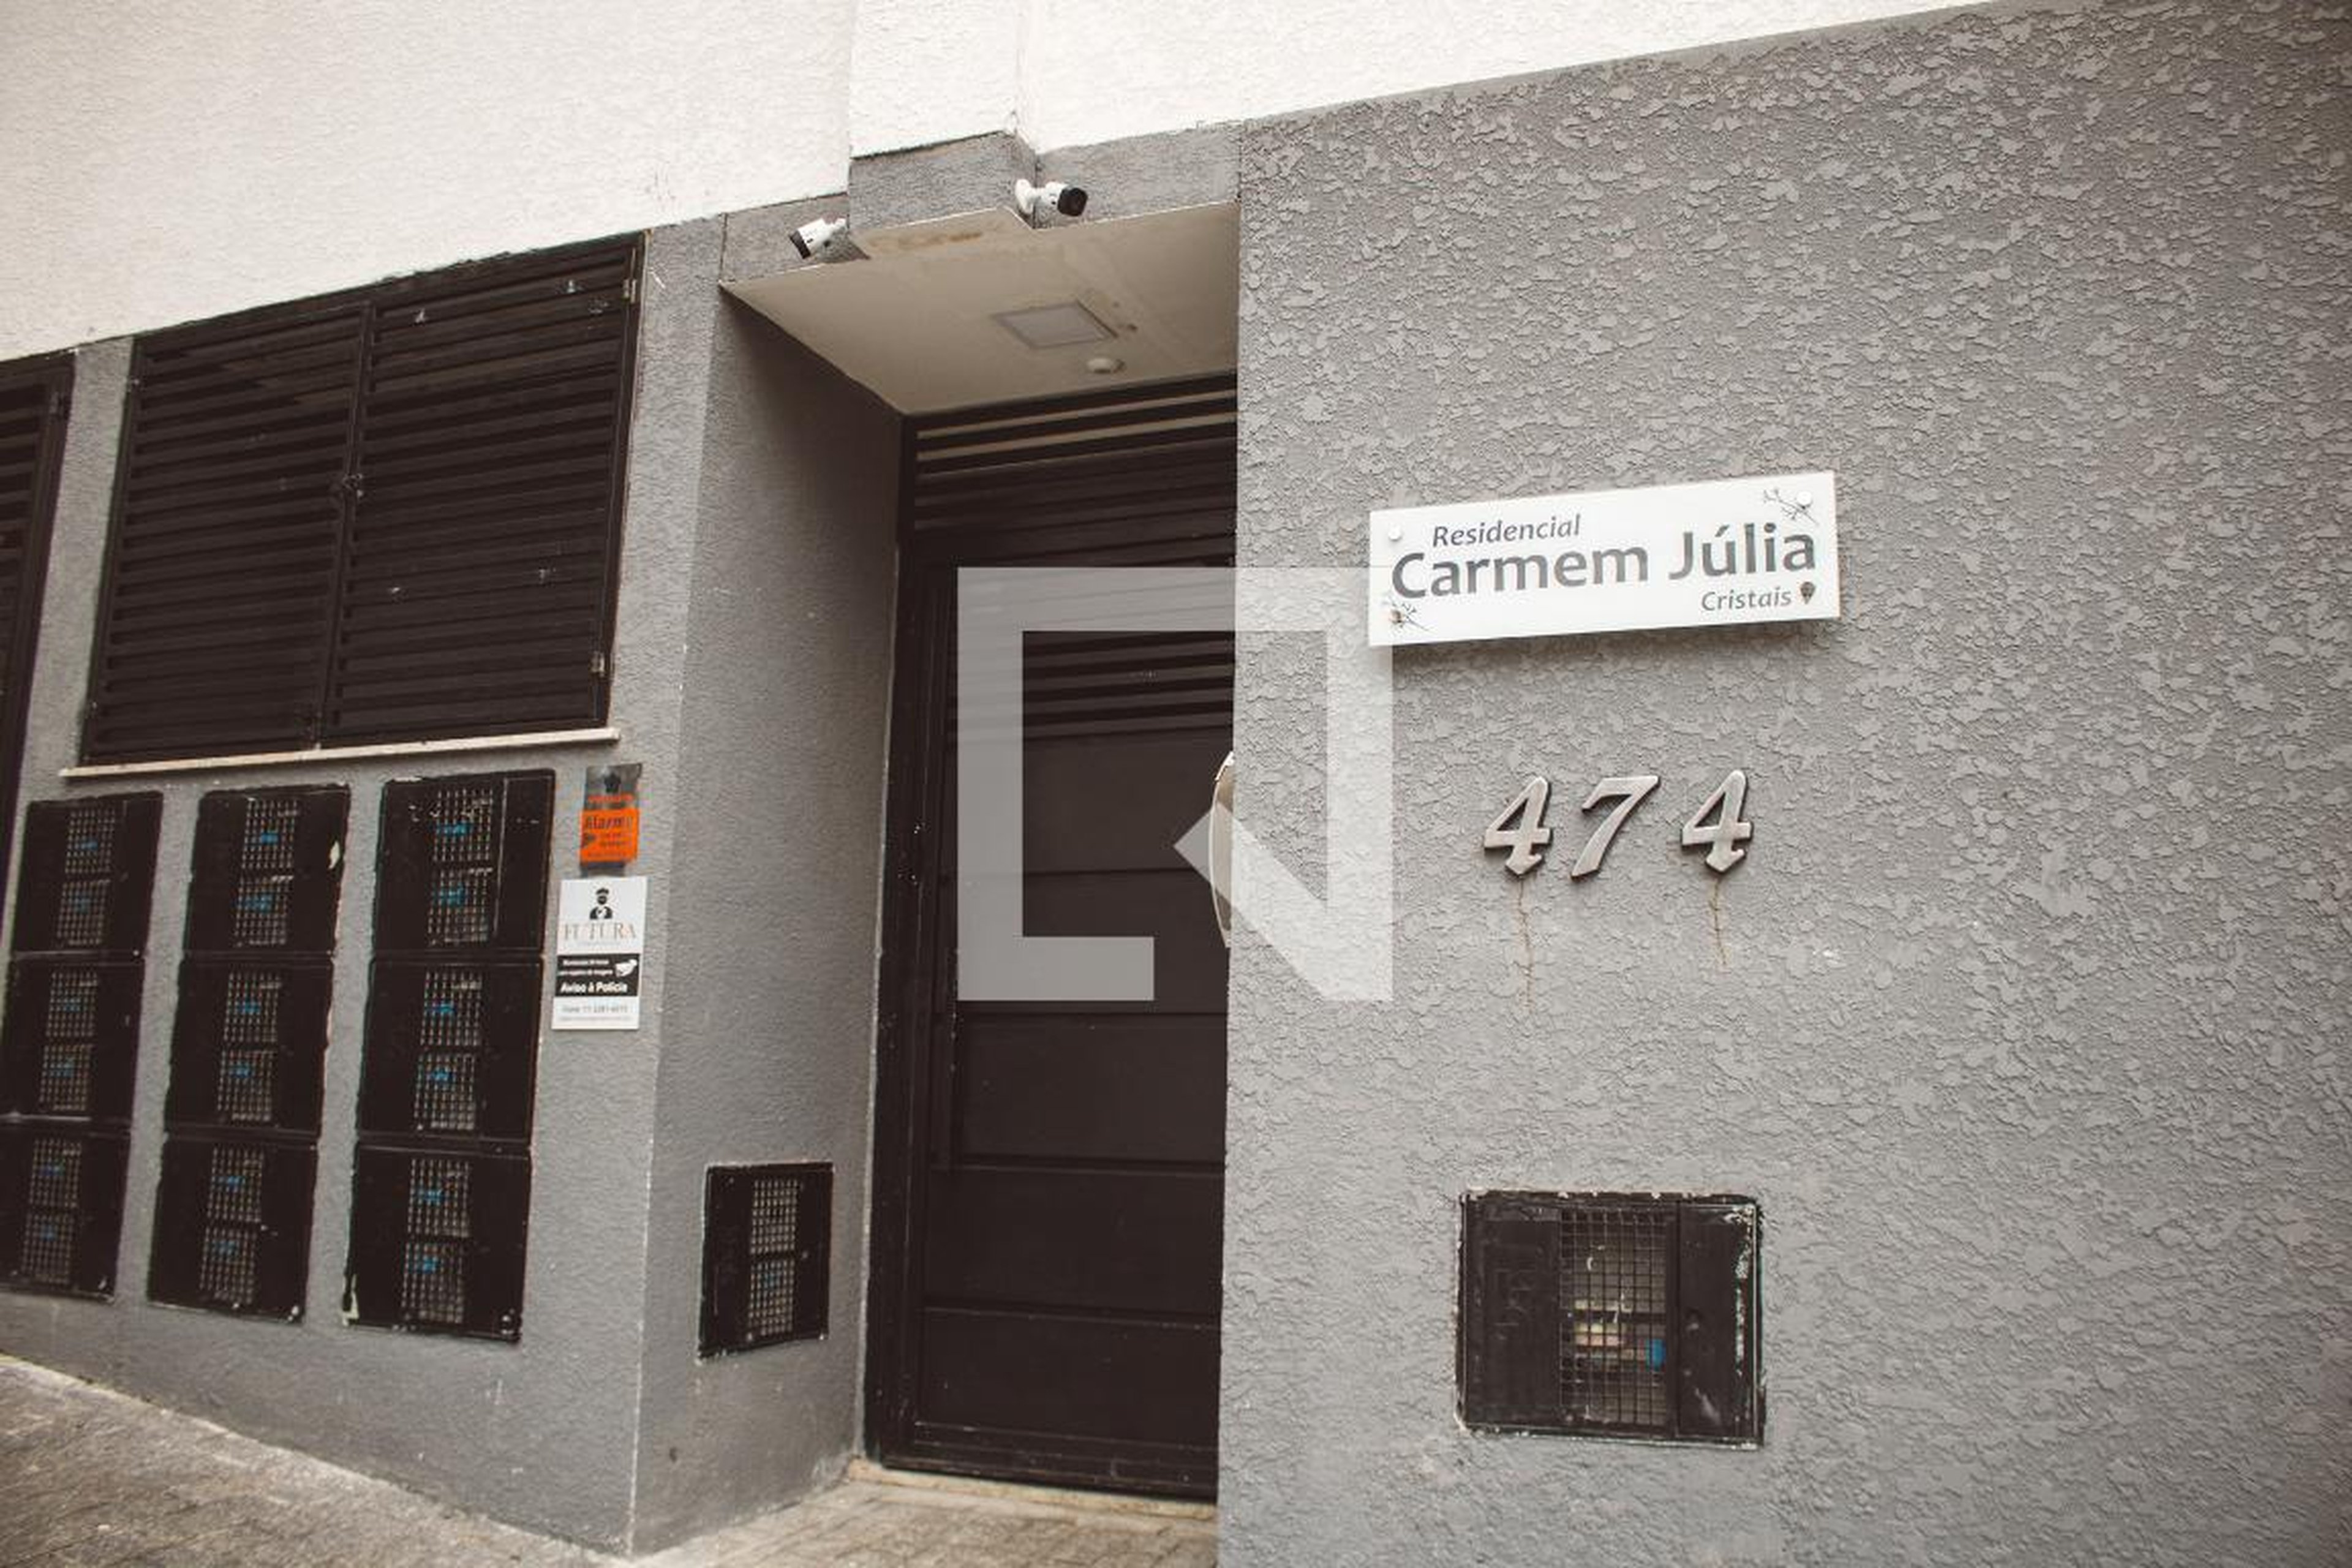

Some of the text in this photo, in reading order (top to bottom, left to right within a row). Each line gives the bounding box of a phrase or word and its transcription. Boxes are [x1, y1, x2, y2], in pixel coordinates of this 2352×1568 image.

[1433, 514, 1580, 548] Residencial
[1392, 522, 1817, 599] Carmem Júlia
[1701, 586, 1792, 612] Cristais
[560, 981, 587, 993] Aviso
